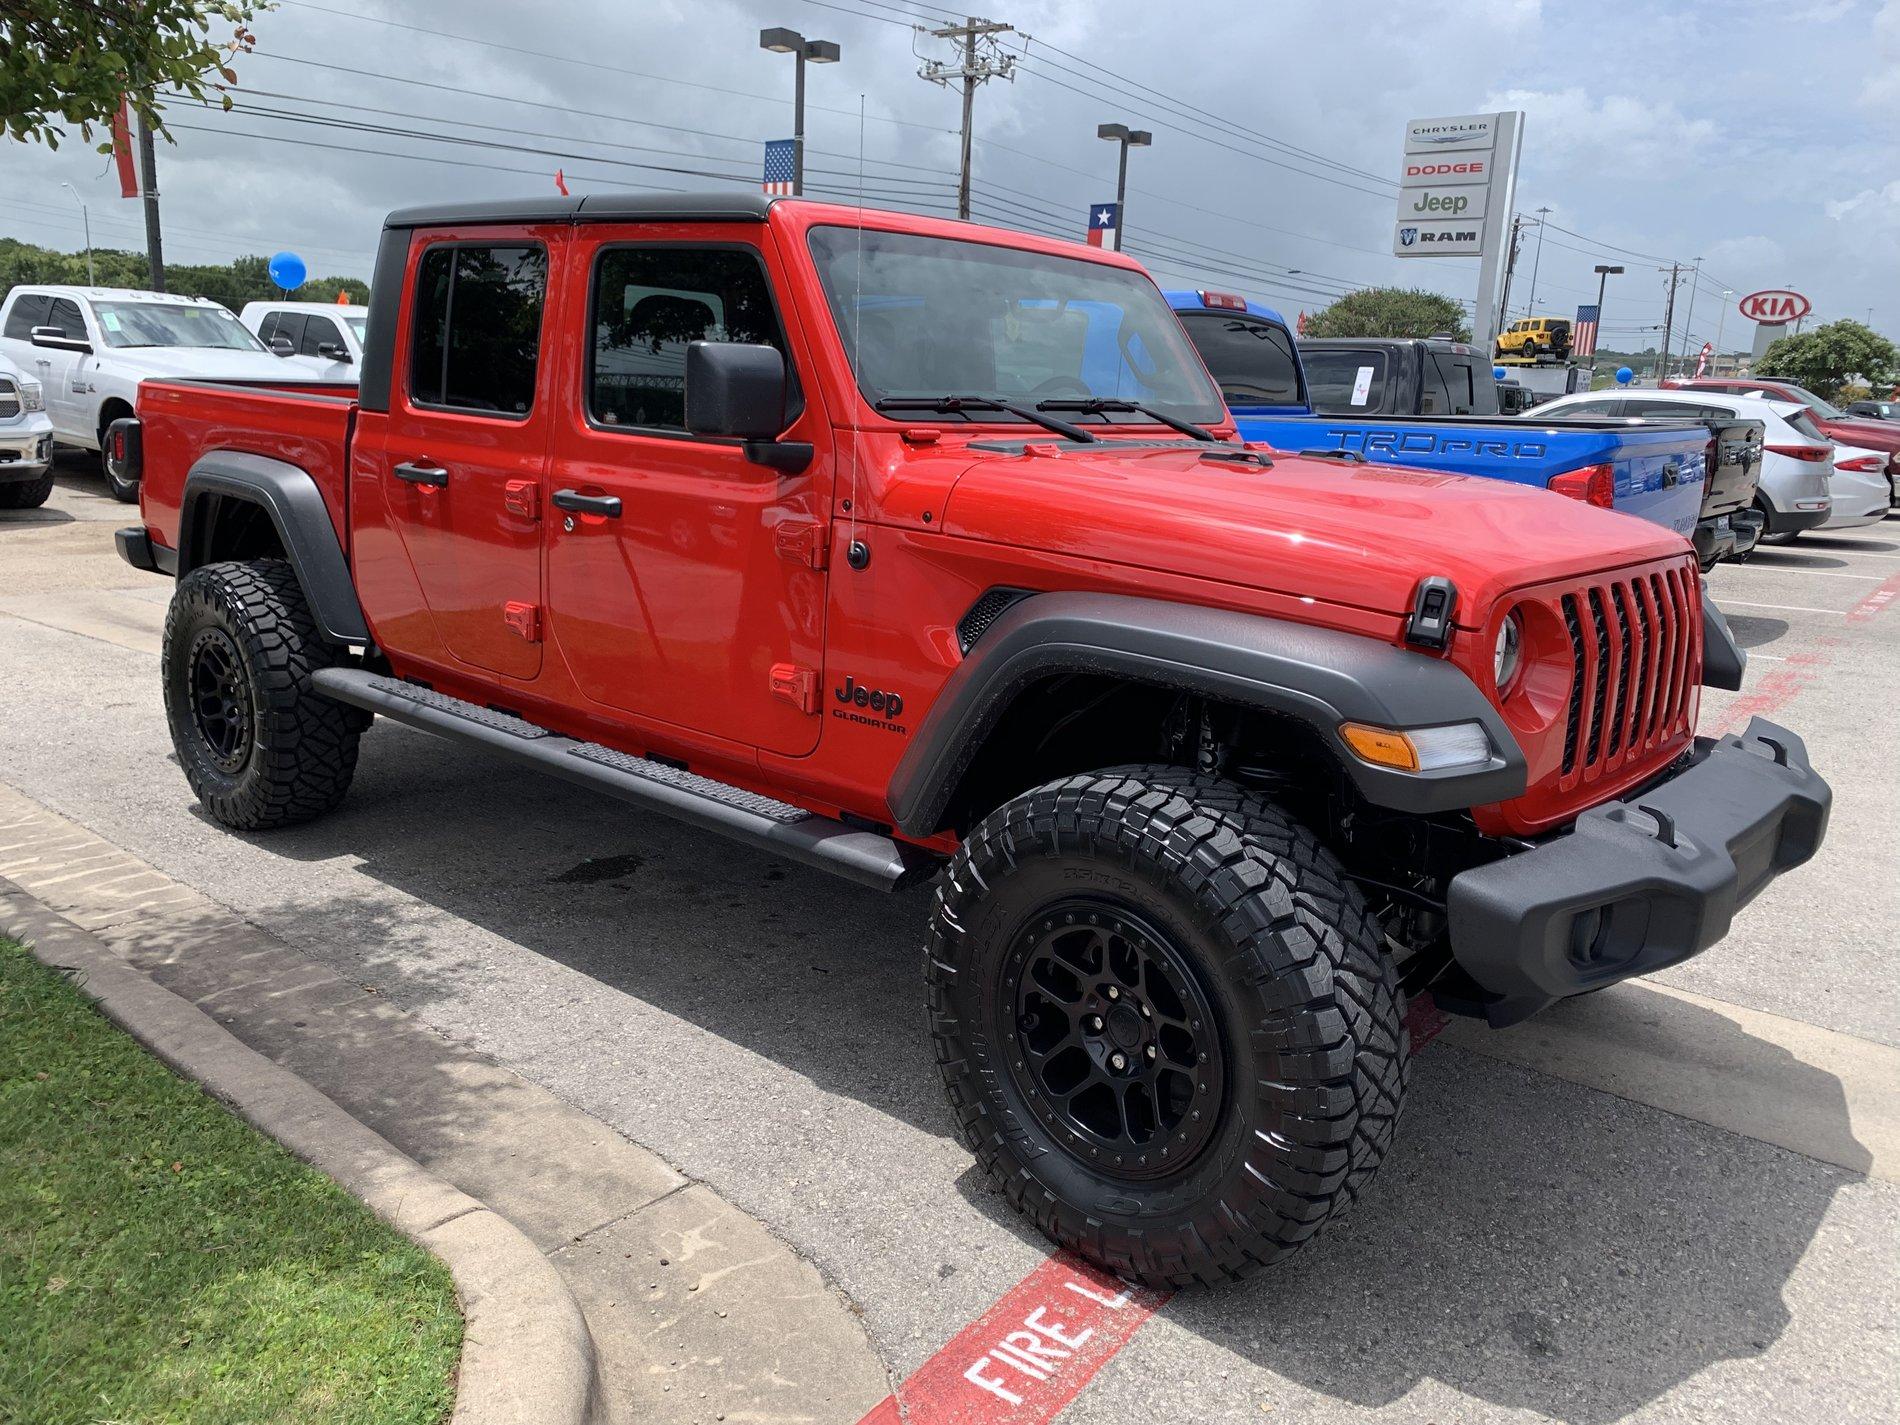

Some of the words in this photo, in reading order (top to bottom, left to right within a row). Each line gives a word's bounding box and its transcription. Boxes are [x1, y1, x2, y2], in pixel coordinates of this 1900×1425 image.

[1413, 123, 1487, 135] CHRYSLER
[1407, 163, 1483, 176] DODGE
[1414, 192, 1468, 214] Jeep
[1420, 231, 1476, 242] RAM
[1751, 298, 1796, 316] KIA
[1327, 430, 1438, 458] TRD
[1438, 439, 1547, 459] PRO
[835, 675, 904, 720] Jeep
[832, 708, 907, 735] GLADIATOR
[963, 1306, 1094, 1405] FIRE
